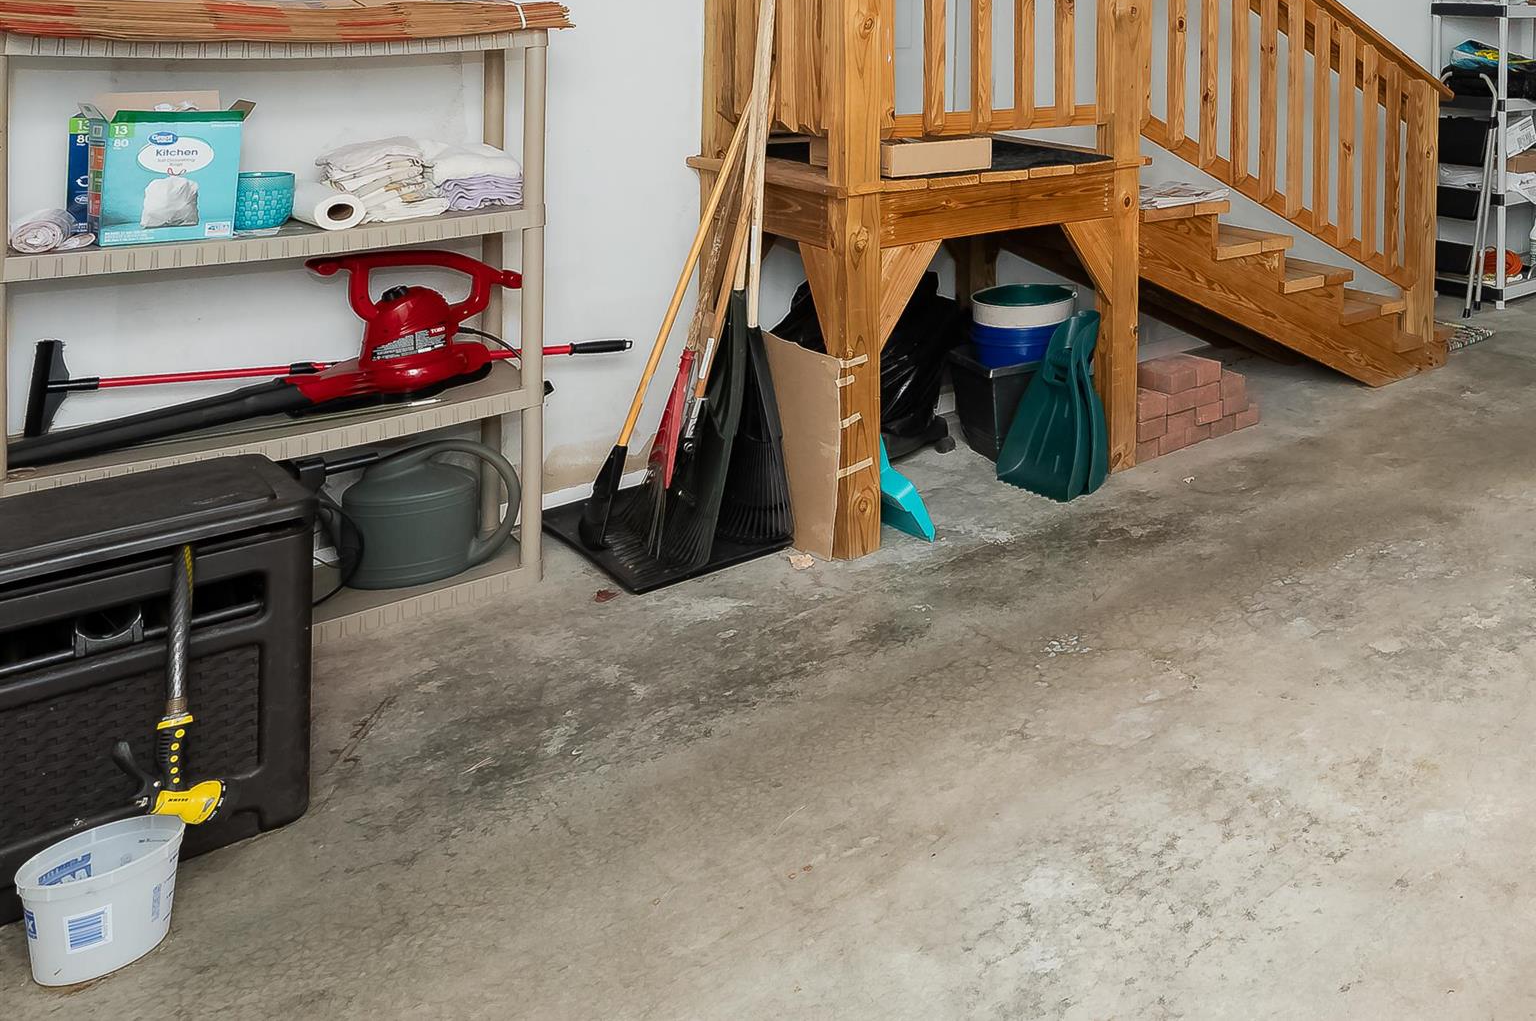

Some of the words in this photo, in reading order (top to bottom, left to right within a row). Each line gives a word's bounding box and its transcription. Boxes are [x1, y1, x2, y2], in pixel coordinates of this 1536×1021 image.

[114, 125, 128, 135] 13
[113, 138, 129, 147] 80
[155, 149, 198, 157] Kitchen
